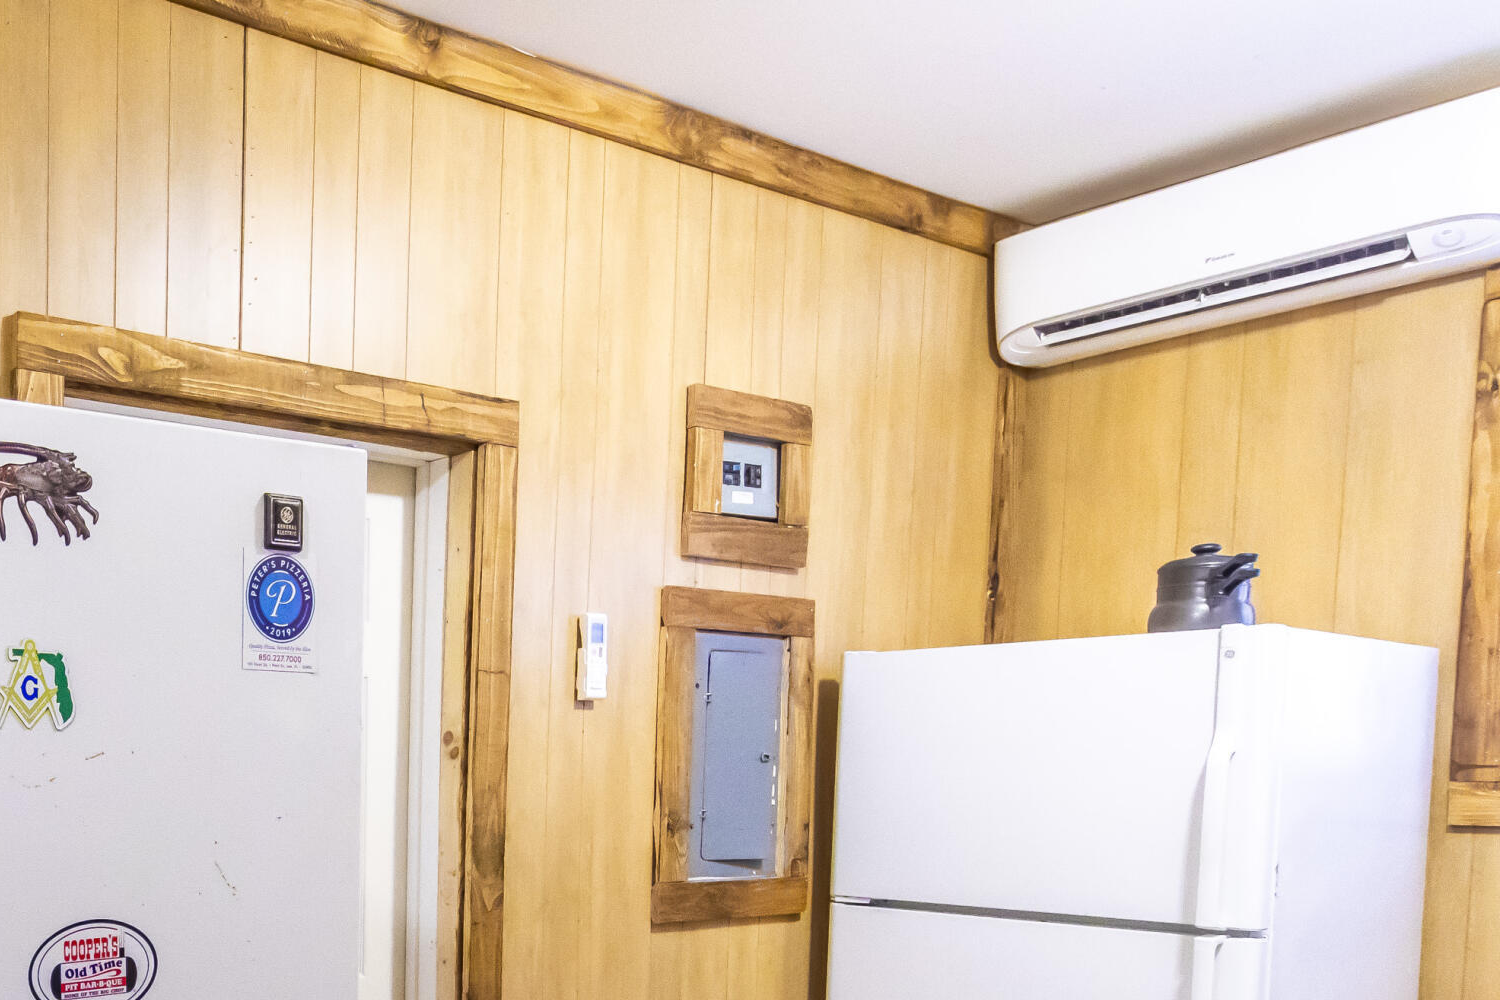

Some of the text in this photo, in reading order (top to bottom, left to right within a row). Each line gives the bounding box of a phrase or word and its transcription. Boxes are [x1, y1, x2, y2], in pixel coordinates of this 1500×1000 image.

[250, 559, 311, 601] PETER'S PIZZERIA
[269, 628, 292, 638] 2019
[20, 675, 39, 701] G
[63, 934, 118, 962] COOPER'S
[65, 960, 123, 979] Old Time
[65, 983, 78, 991] PIT
